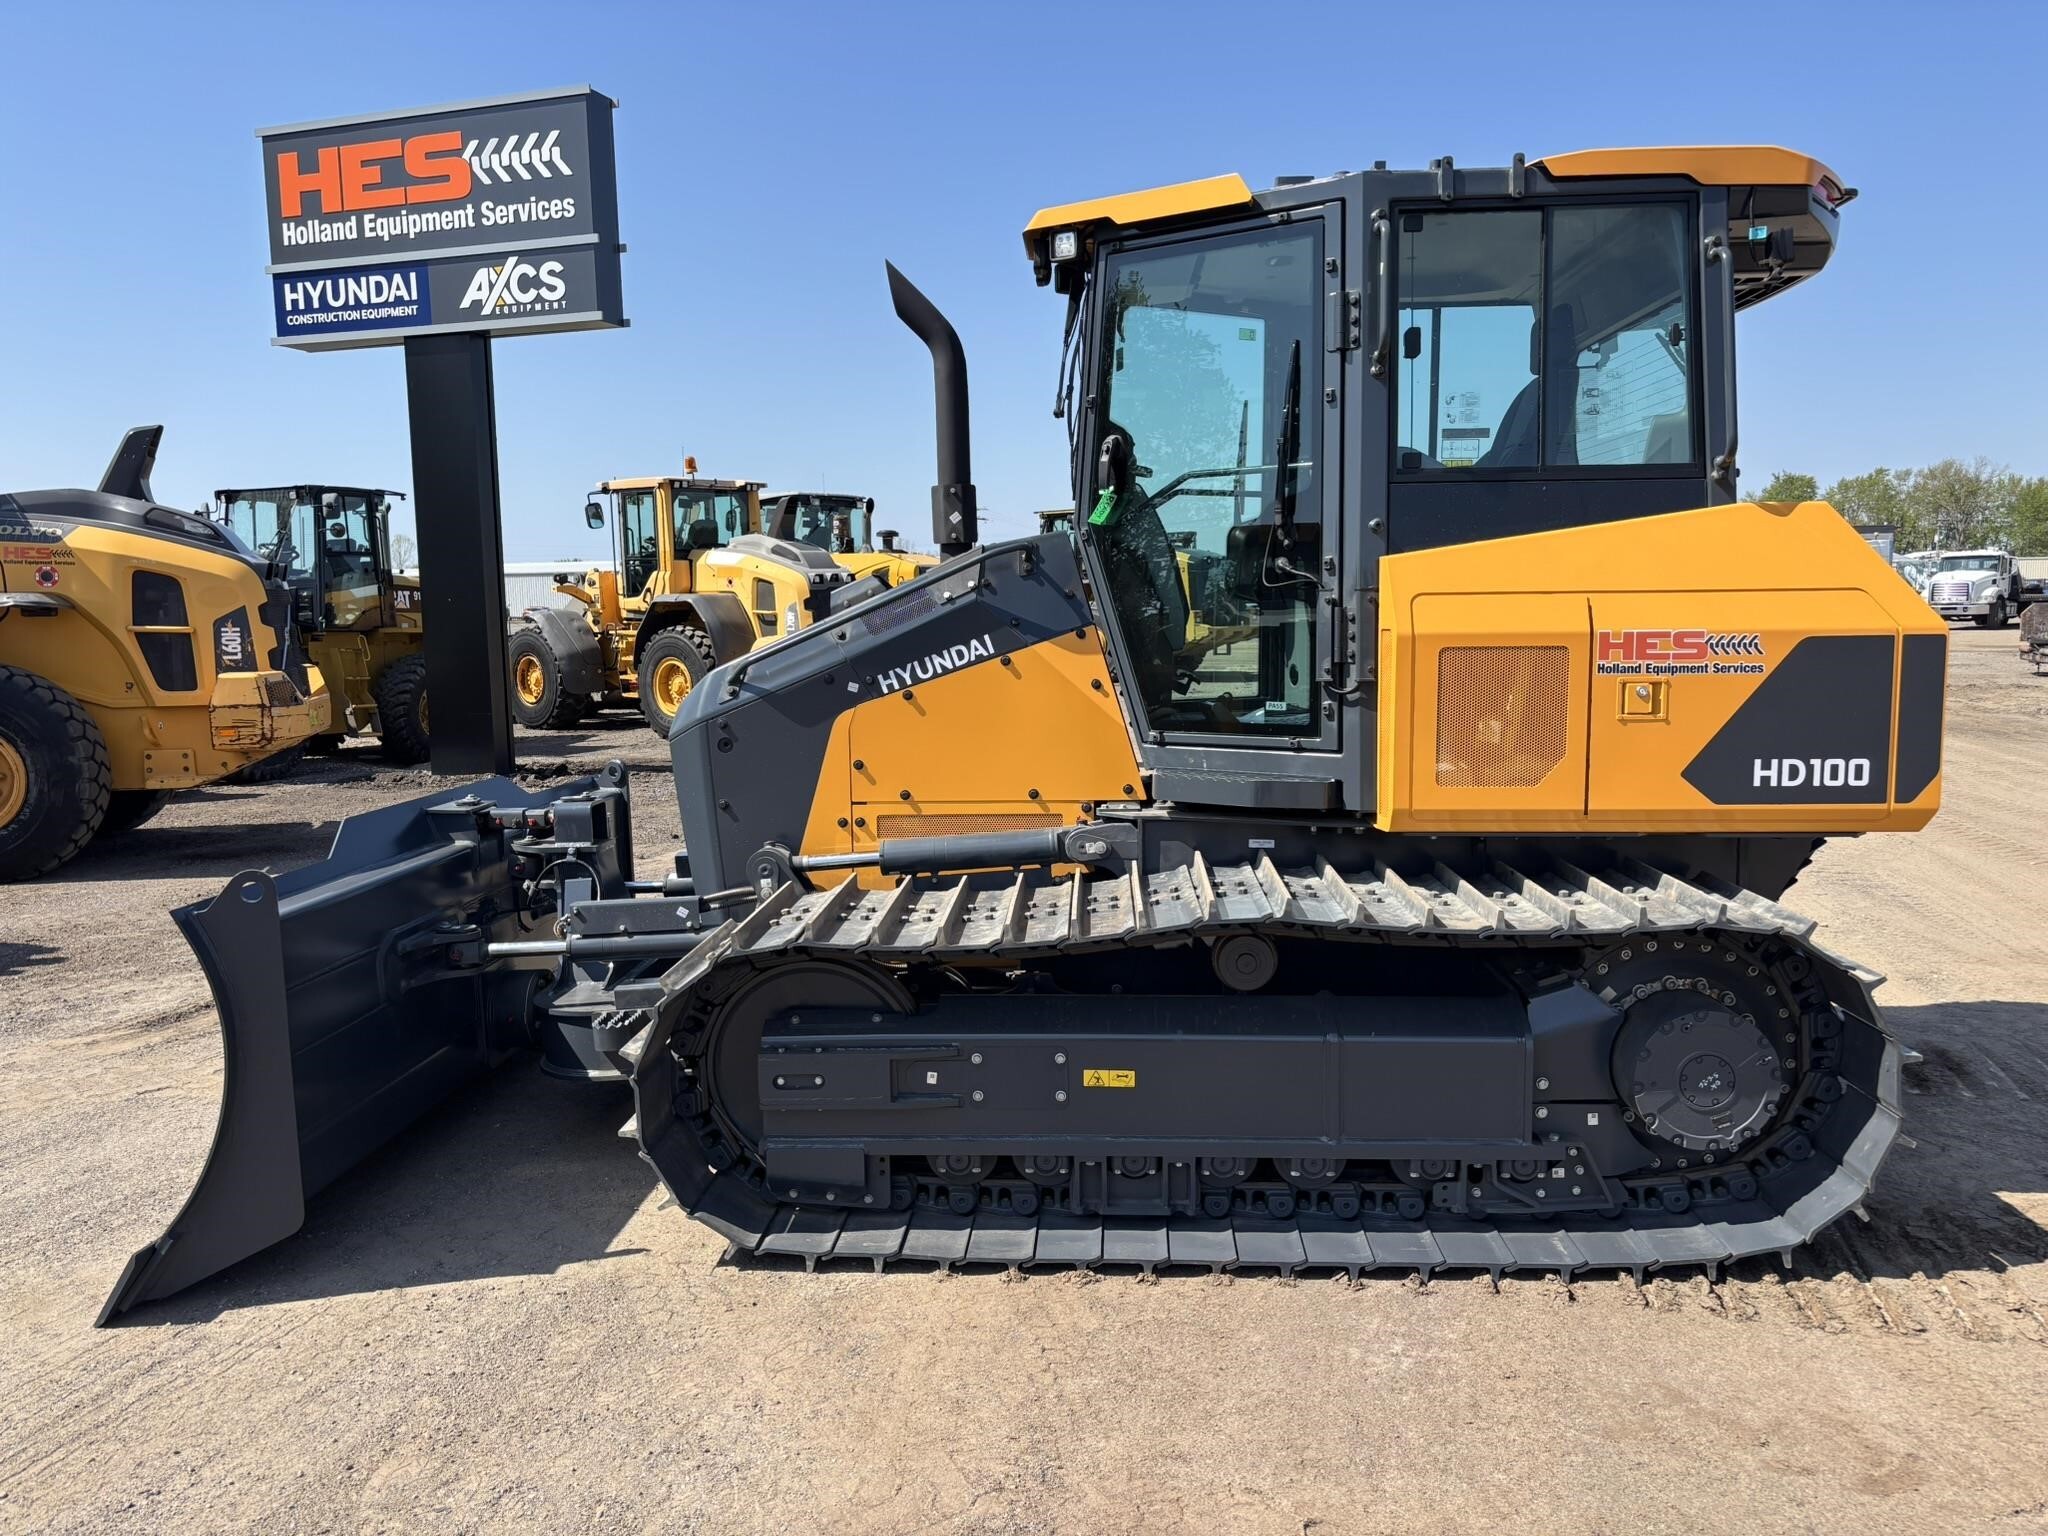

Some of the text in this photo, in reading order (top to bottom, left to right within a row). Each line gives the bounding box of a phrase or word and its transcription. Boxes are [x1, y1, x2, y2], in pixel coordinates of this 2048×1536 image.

[277, 130, 472, 218] HES
[282, 196, 576, 246] Holland Equipment Services
[284, 271, 418, 311] HYUNDAI
[459, 255, 566, 316] AXCS
[286, 304, 419, 326] CONSTRUCTION EQUIPMENT
[495, 300, 567, 315] EQUIPMENT
[3, 546, 53, 560] HES
[221, 627, 242, 660] L60H
[1599, 630, 1709, 661] HES
[877, 633, 996, 694] HYUNDAI
[1598, 663, 1764, 676] Holland Equipment Services
[1752, 758, 1870, 787] HD100
